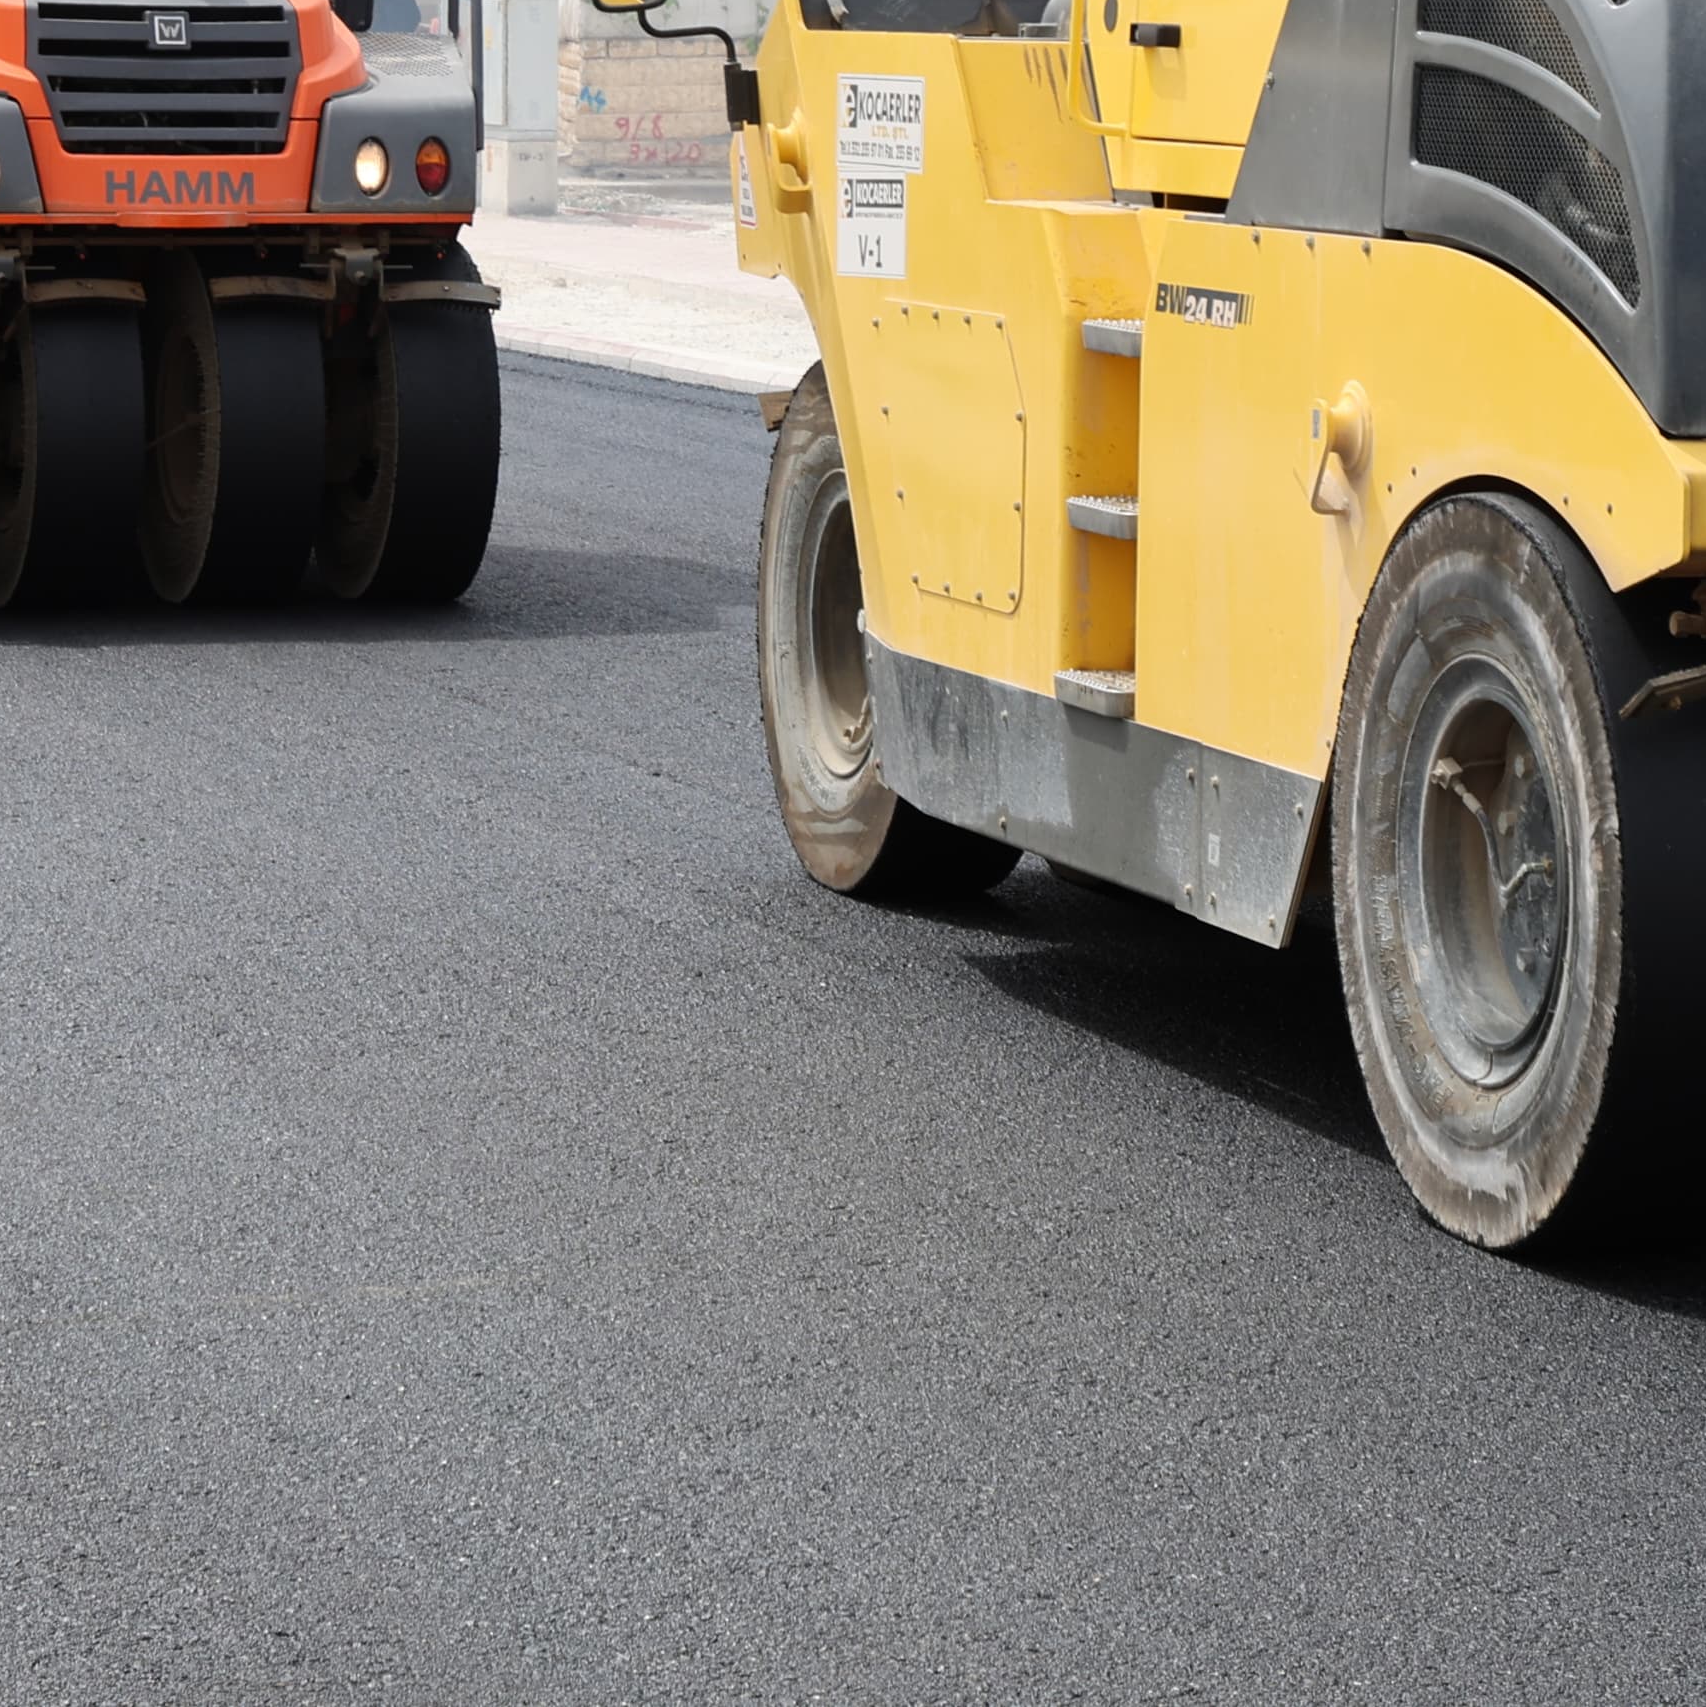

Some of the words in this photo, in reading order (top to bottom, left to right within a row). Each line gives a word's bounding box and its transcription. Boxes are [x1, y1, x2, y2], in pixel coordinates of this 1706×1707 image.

[858, 91, 922, 124] KOCAERLER
[104, 169, 256, 206] HAMM
[855, 182, 903, 206] KOCAERLER
[857, 234, 883, 269] V-1
